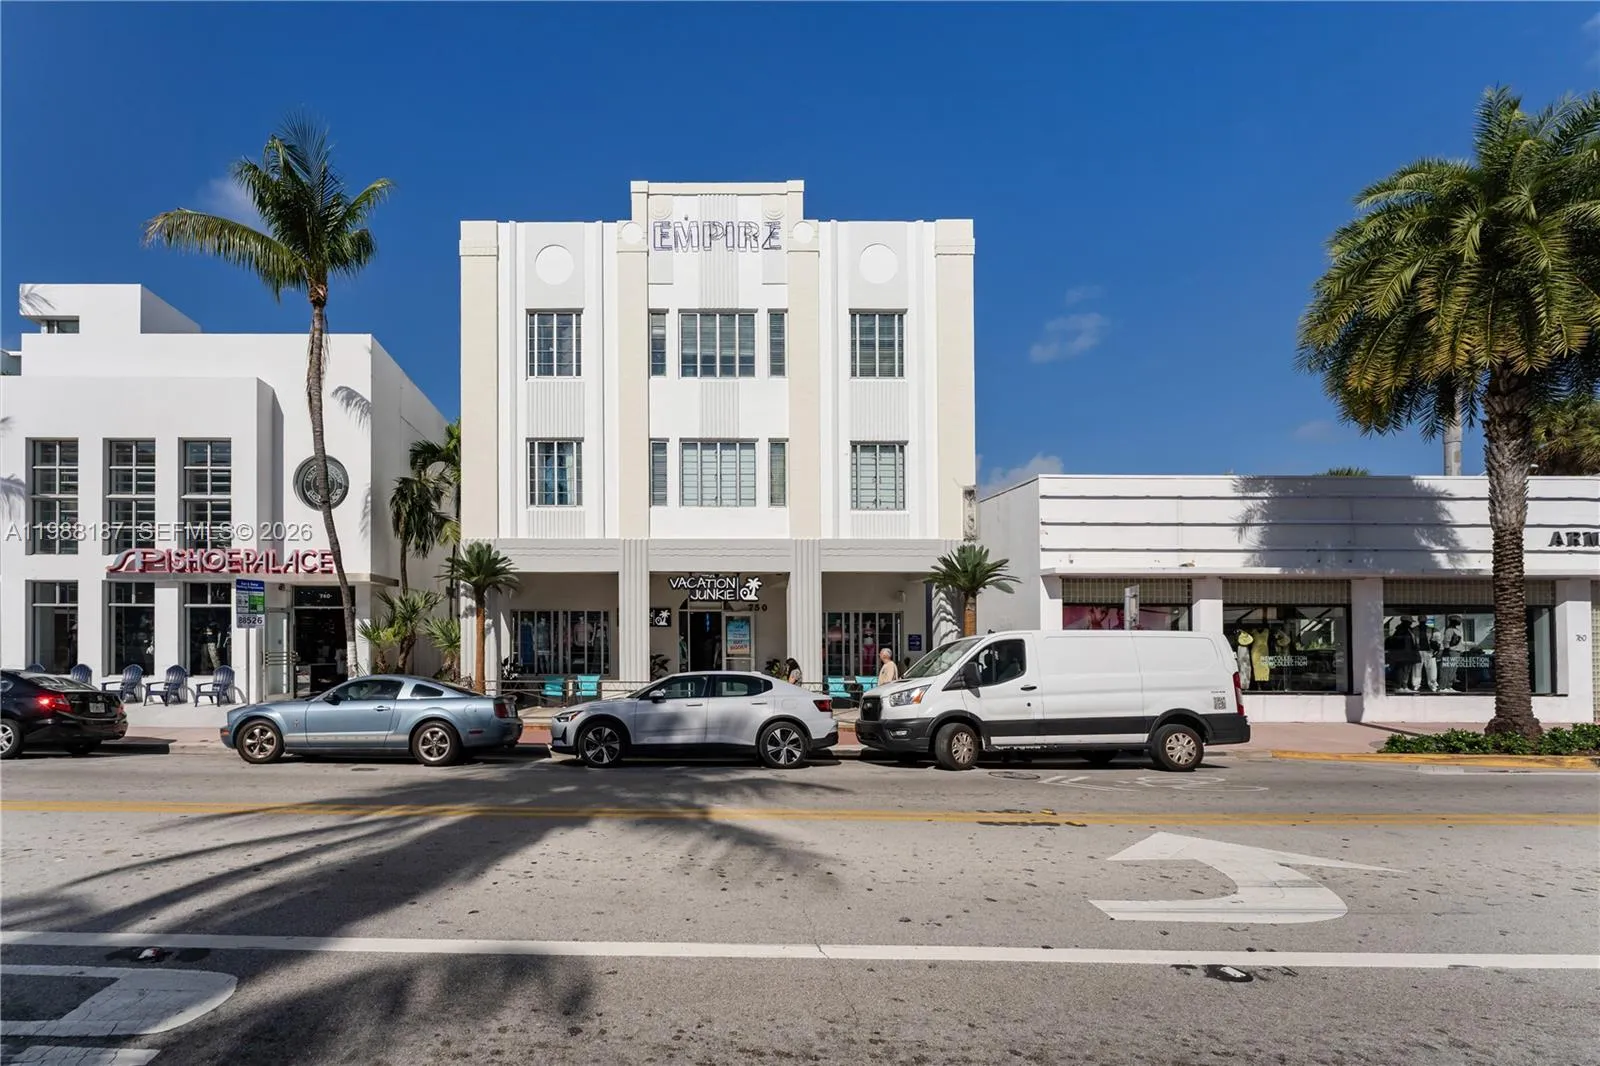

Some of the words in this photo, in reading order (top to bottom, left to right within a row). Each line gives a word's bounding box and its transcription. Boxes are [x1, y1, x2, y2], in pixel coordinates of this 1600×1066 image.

[670, 577, 736, 589] VACATION
[690, 589, 735, 600] JUNKIE
[748, 604, 768, 612] 750
[238, 616, 264, 625] 88526
